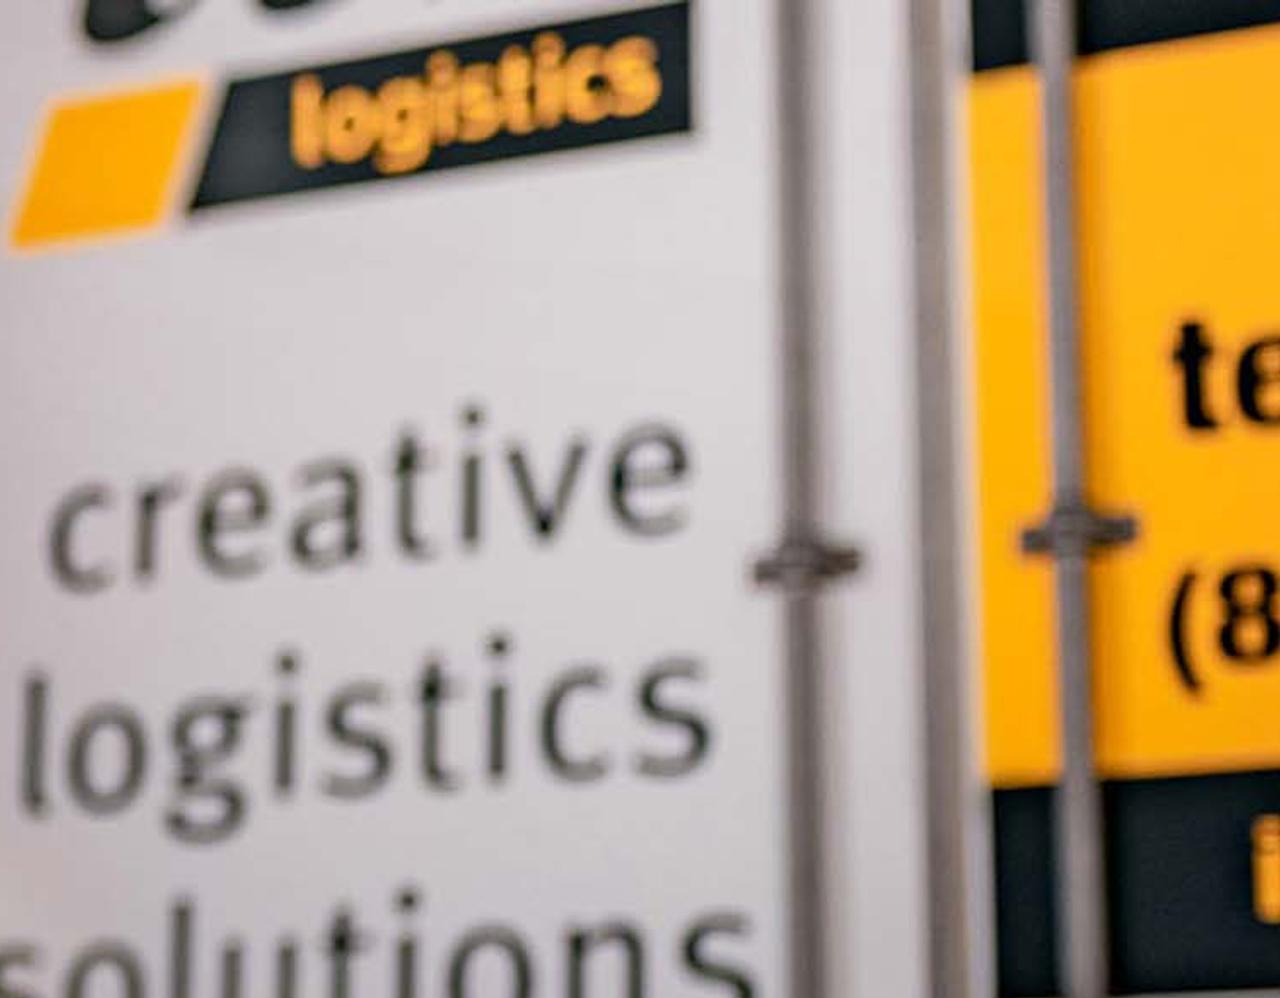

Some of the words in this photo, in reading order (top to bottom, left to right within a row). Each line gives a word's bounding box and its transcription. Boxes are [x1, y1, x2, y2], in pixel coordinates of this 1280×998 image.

[290, 32, 662, 175] logistics
[48, 405, 690, 593] creative
[20, 632, 714, 845] logistics
